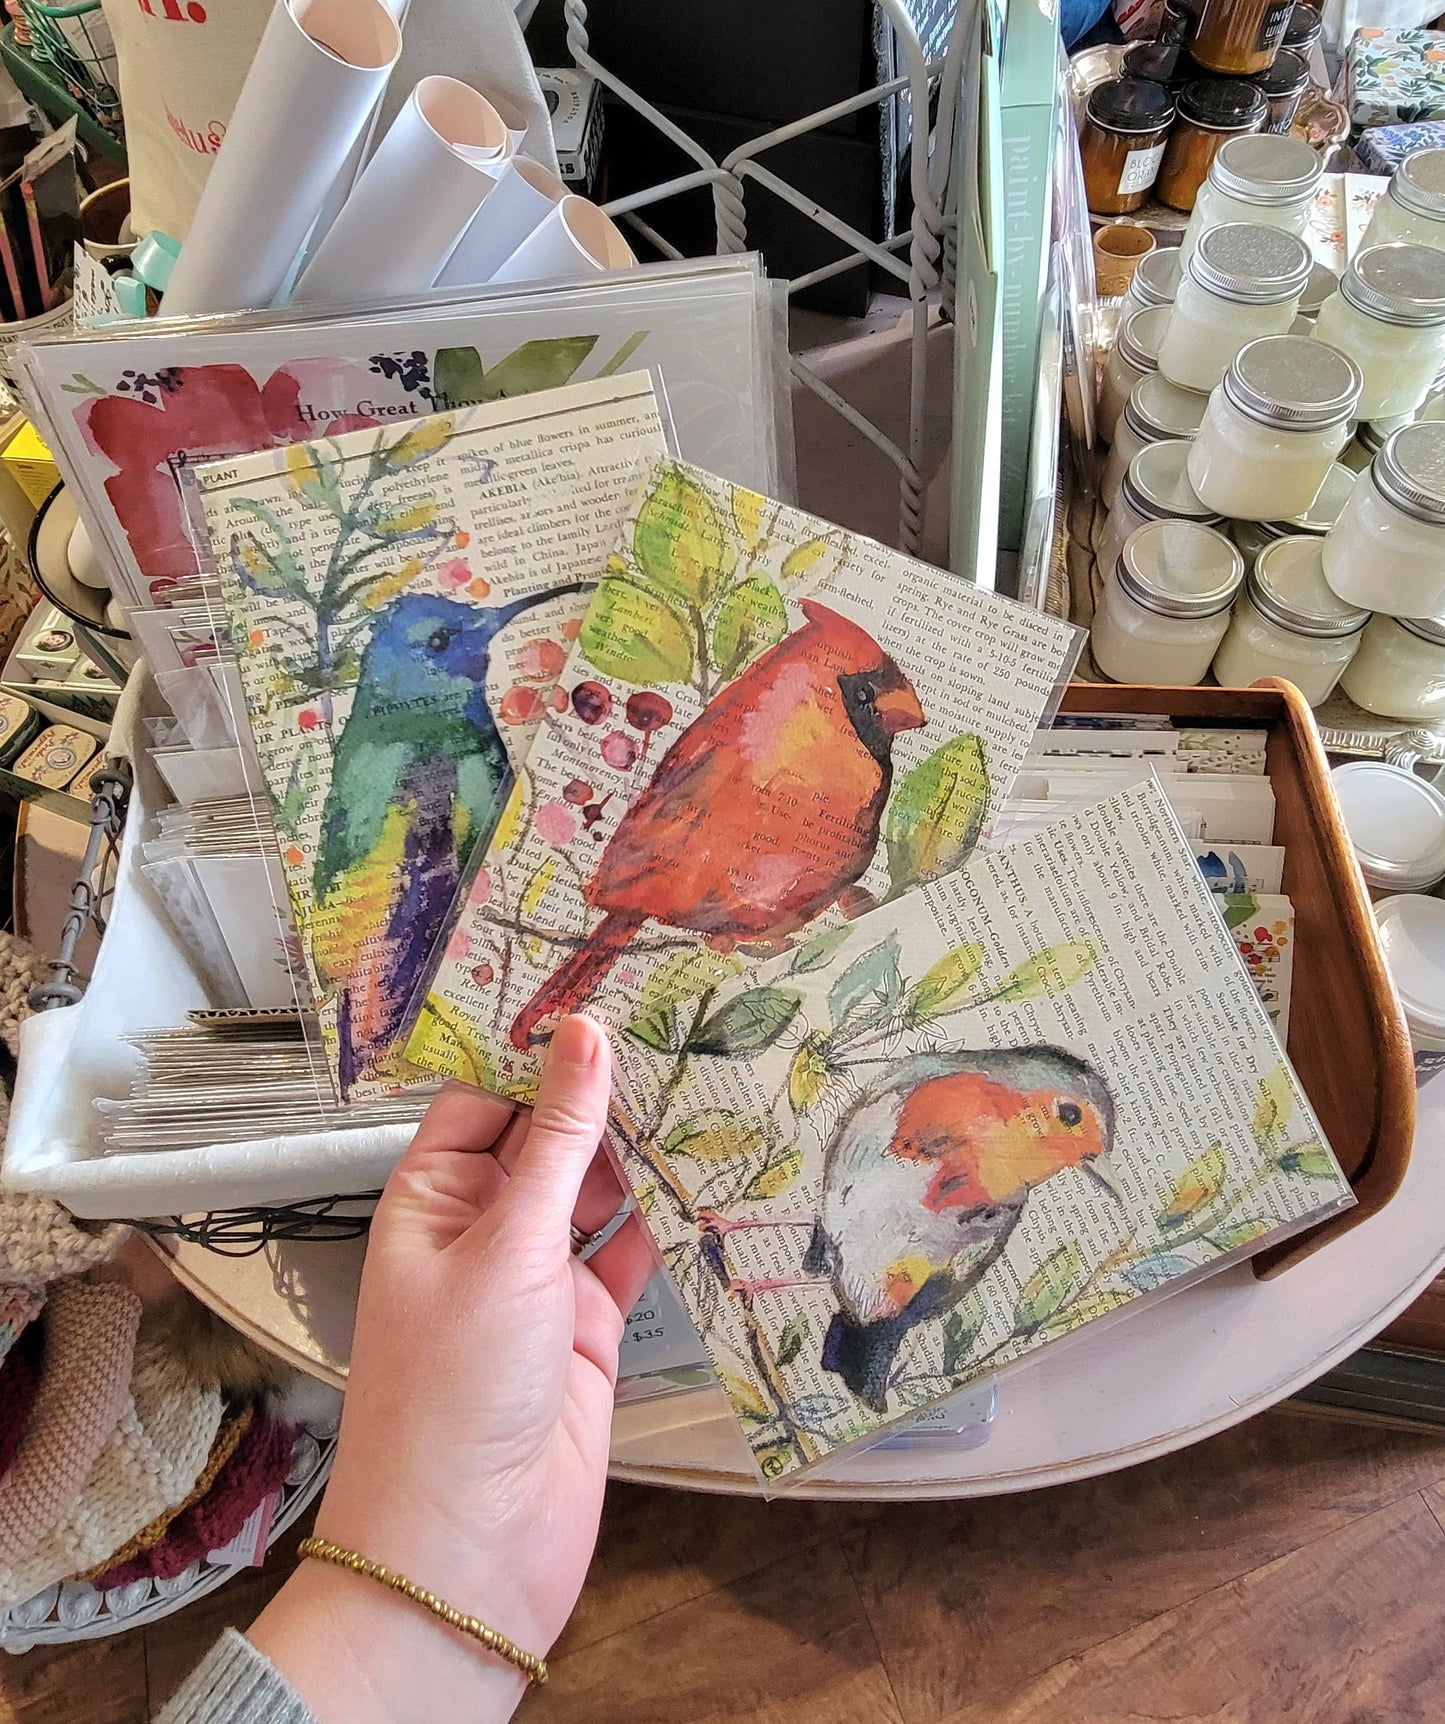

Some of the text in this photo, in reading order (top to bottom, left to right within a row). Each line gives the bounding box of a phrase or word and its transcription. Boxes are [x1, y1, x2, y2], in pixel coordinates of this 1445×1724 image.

[1002, 135, 1038, 384] paint-by-number
[297, 403, 348, 422] How
[357, 399, 418, 418] Great
[504, 432, 613, 465] metallica crispa has
[508, 414, 640, 449] blue flowers summer,
[203, 468, 239, 484] PLANT
[478, 481, 527, 499] AKEBIA
[556, 499, 577, 512] and
[579, 489, 620, 506] wooden
[477, 506, 611, 544] are ideal climbers for the
[480, 524, 591, 560] belong the family
[483, 537, 607, 572] wild China, Japan
[502, 574, 573, 599] Planting and
[900, 567, 1050, 636] organic material disced
[890, 593, 1045, 667] crops. The cover crop will grow
[895, 580, 1047, 650] spring. Rye and Rye Grass are
[900, 611, 945, 638] fertilized
[948, 632, 972, 649] with
[875, 631, 986, 686] when the crop sown.
[952, 648, 1051, 698] rate 250 pounds
[914, 678, 1031, 734] kept sod mulched.
[945, 676, 1011, 711] sloping land
[549, 717, 574, 734] days
[937, 702, 1018, 747] moisture supply
[1063, 830, 1087, 869] flowers.
[1078, 832, 1097, 857] only
[1153, 796, 1182, 844] Northern
[1176, 846, 1194, 872] Star,
[1091, 858, 1113, 890] about
[1095, 801, 1188, 986] double varieties there are the Double
[1128, 808, 1212, 974] tricolor, white, marked with crim-
[1135, 791, 1225, 967] Burridgeanum, white, marked with
[1052, 838, 1139, 1011] Uses. The inflorescences Chrysan-
[1088, 819, 1176, 993] Double Yellow, and Bridal Robe,
[1112, 902, 1126, 919] in.
[1118, 920, 1138, 945] high
[1043, 884, 1114, 1023] manufacture Pyrethrum
[1133, 947, 1150, 968] and
[1028, 918, 1089, 1037] botanical term meaning
[1144, 970, 1163, 998] bears
[442, 984, 491, 1014] excellent
[448, 1002, 482, 1026] Royal
[465, 1025, 491, 1044] Tree
[1195, 986, 1245, 1074] poor soil their
[1214, 990, 1273, 1101] Suitable for Dry Soil.
[420, 1039, 460, 1067] usually
[1146, 1011, 1197, 1103] apart. Propagation
[729, 1064, 755, 1110] excellent
[1110, 1029, 1163, 1129] bloom following
[1140, 1029, 1194, 1128] planting time. Seeds
[1115, 1070, 1148, 1127] chief kinds
[1204, 1065, 1252, 1154] herbaceous plants
[748, 1242, 766, 1269] must
[632, 1326, 665, 1343] $35
[912, 1331, 939, 1374] Shading
